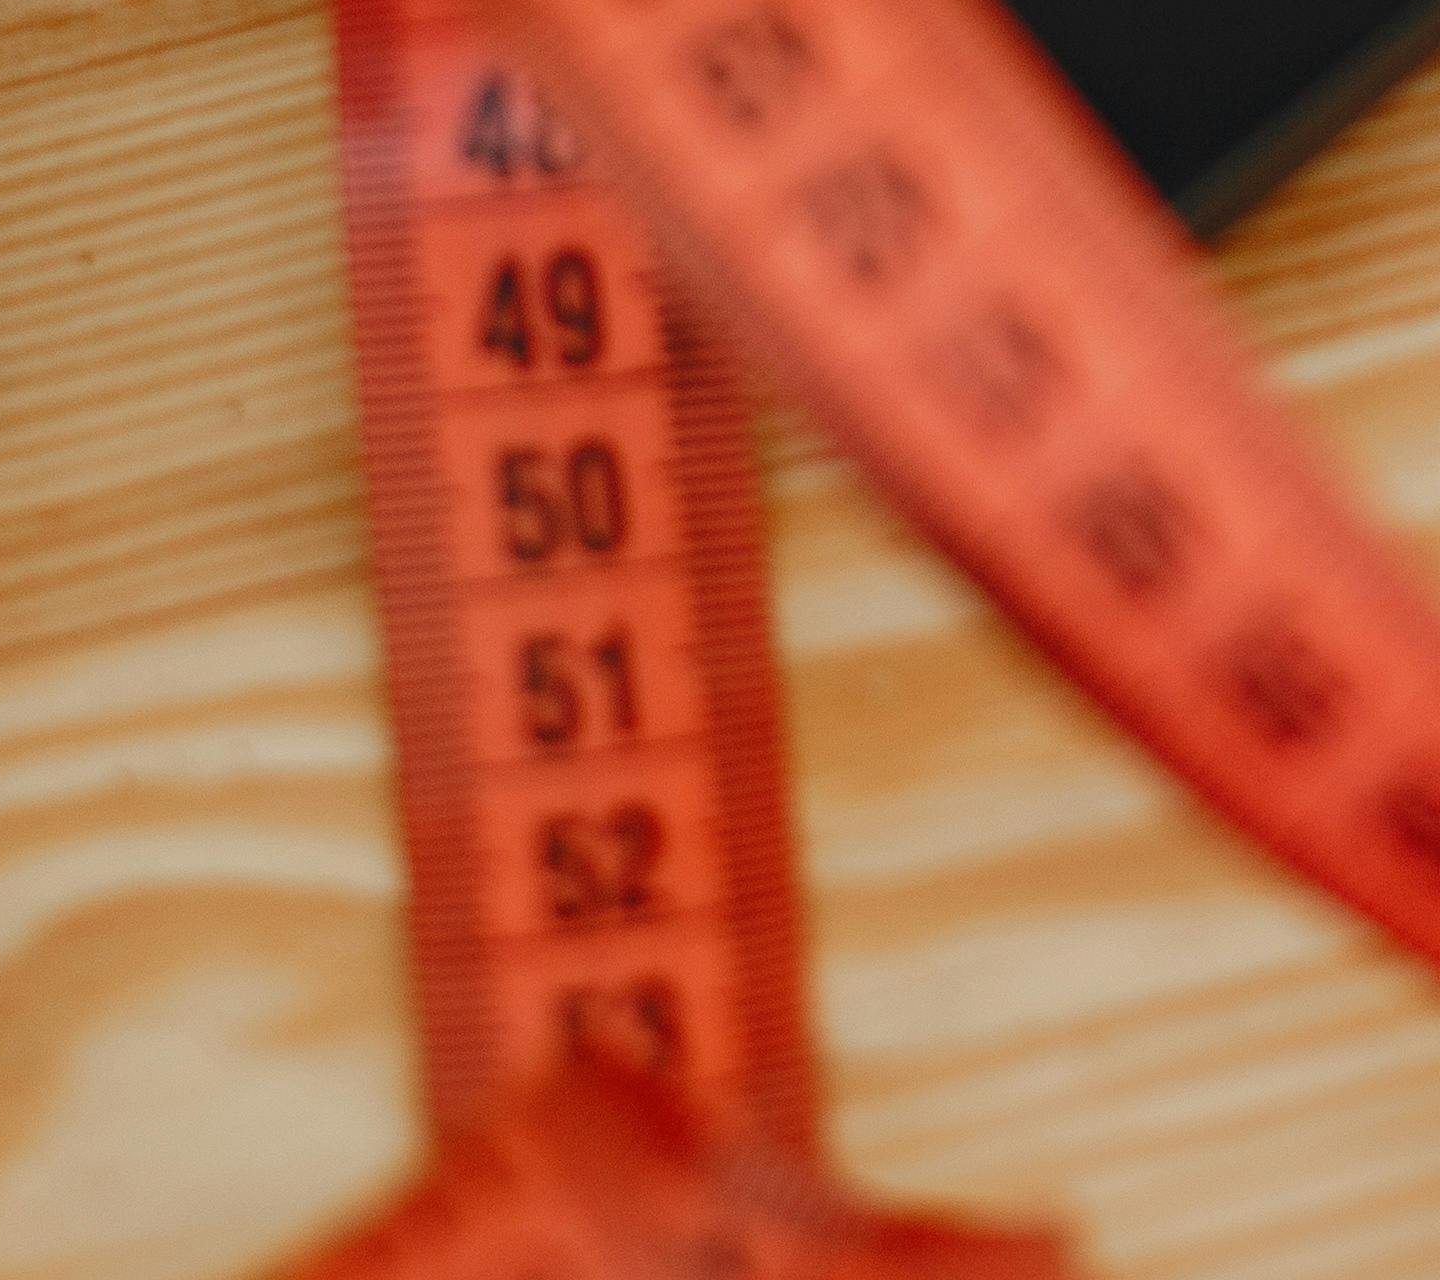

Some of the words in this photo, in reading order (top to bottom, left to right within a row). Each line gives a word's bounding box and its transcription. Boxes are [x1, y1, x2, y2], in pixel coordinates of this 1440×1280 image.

[474, 245, 604, 368] 49
[498, 436, 627, 561] 50
[518, 626, 638, 746] 51
[540, 800, 665, 926] 52
